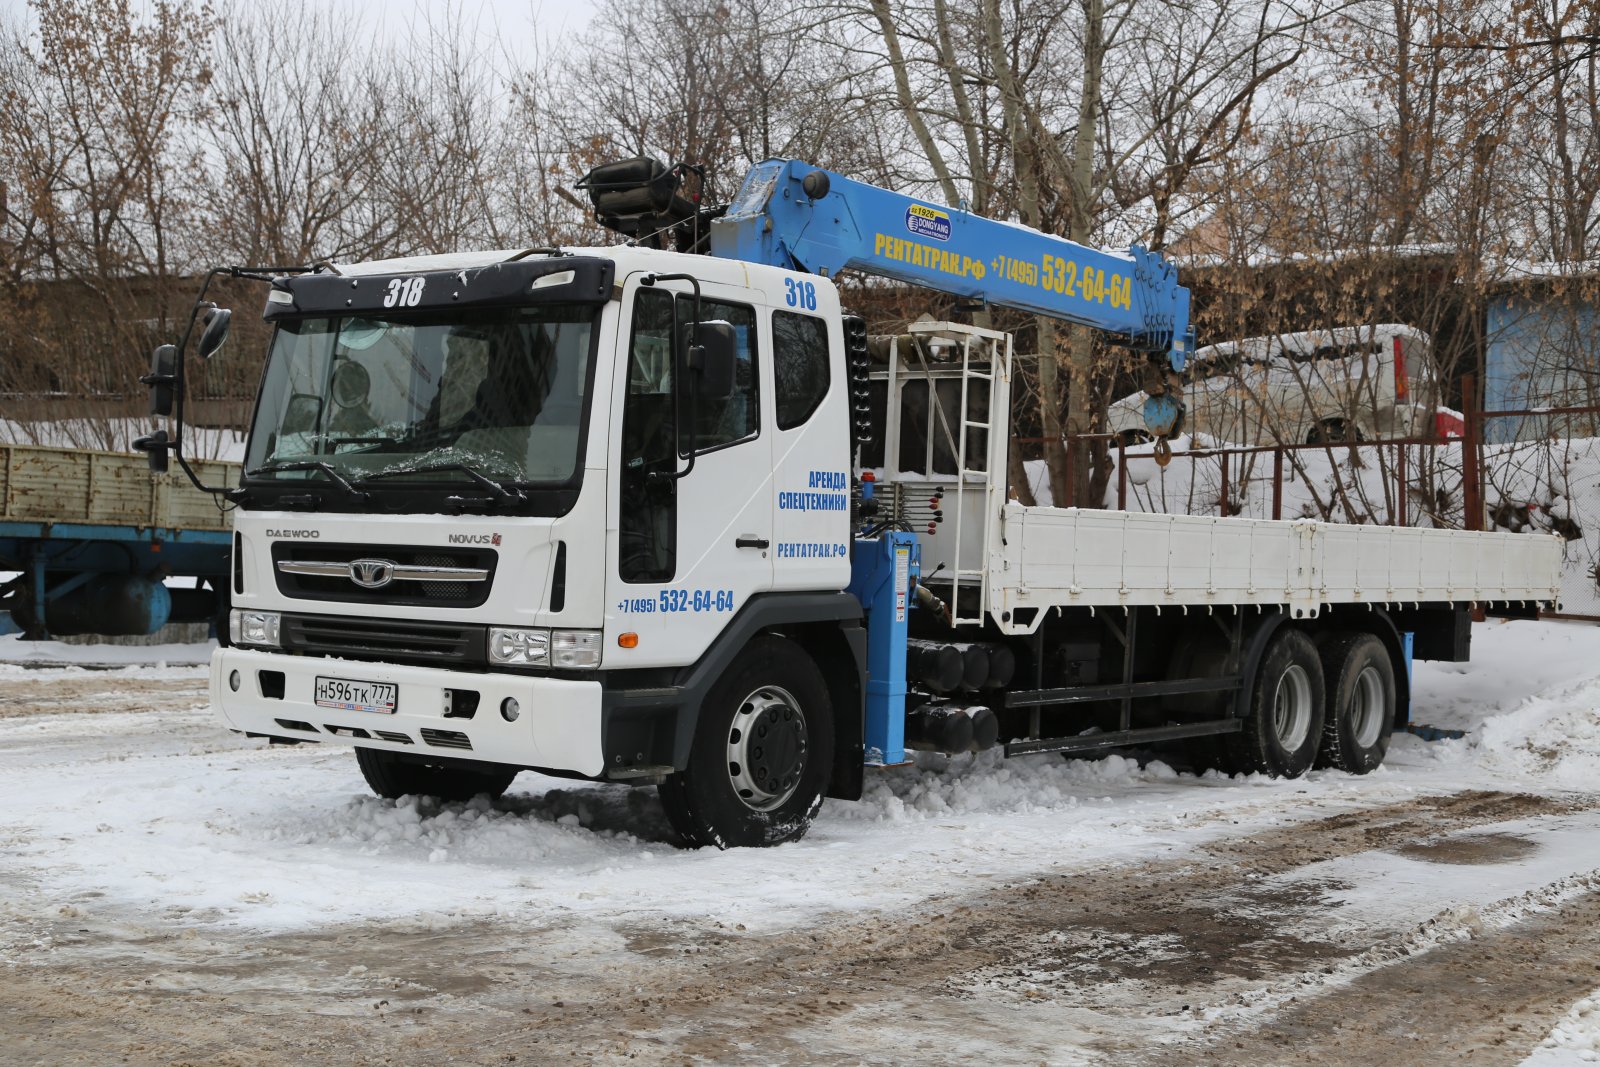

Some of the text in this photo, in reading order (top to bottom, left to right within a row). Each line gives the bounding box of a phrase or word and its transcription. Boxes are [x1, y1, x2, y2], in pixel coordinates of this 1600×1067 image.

[918, 218, 949, 234] DONGYANG
[874, 233, 986, 280] РЕНТАТРАК.РФ
[991, 253, 1132, 311] +7 (495) 532-64-64
[383, 277, 425, 308] 318
[784, 277, 817, 311] 318
[808, 471, 847, 490] АРЕНДА
[778, 492, 847, 512] СПЕЦТЕХНИКИ
[266, 529, 320, 538] DAEWOO
[448, 533, 491, 544] NOVUS
[777, 542, 847, 558] РЕНТАТРАК.РФ
[617, 589, 734, 613] +7 (495) 532-64-64
[371, 684, 392, 700] 777
